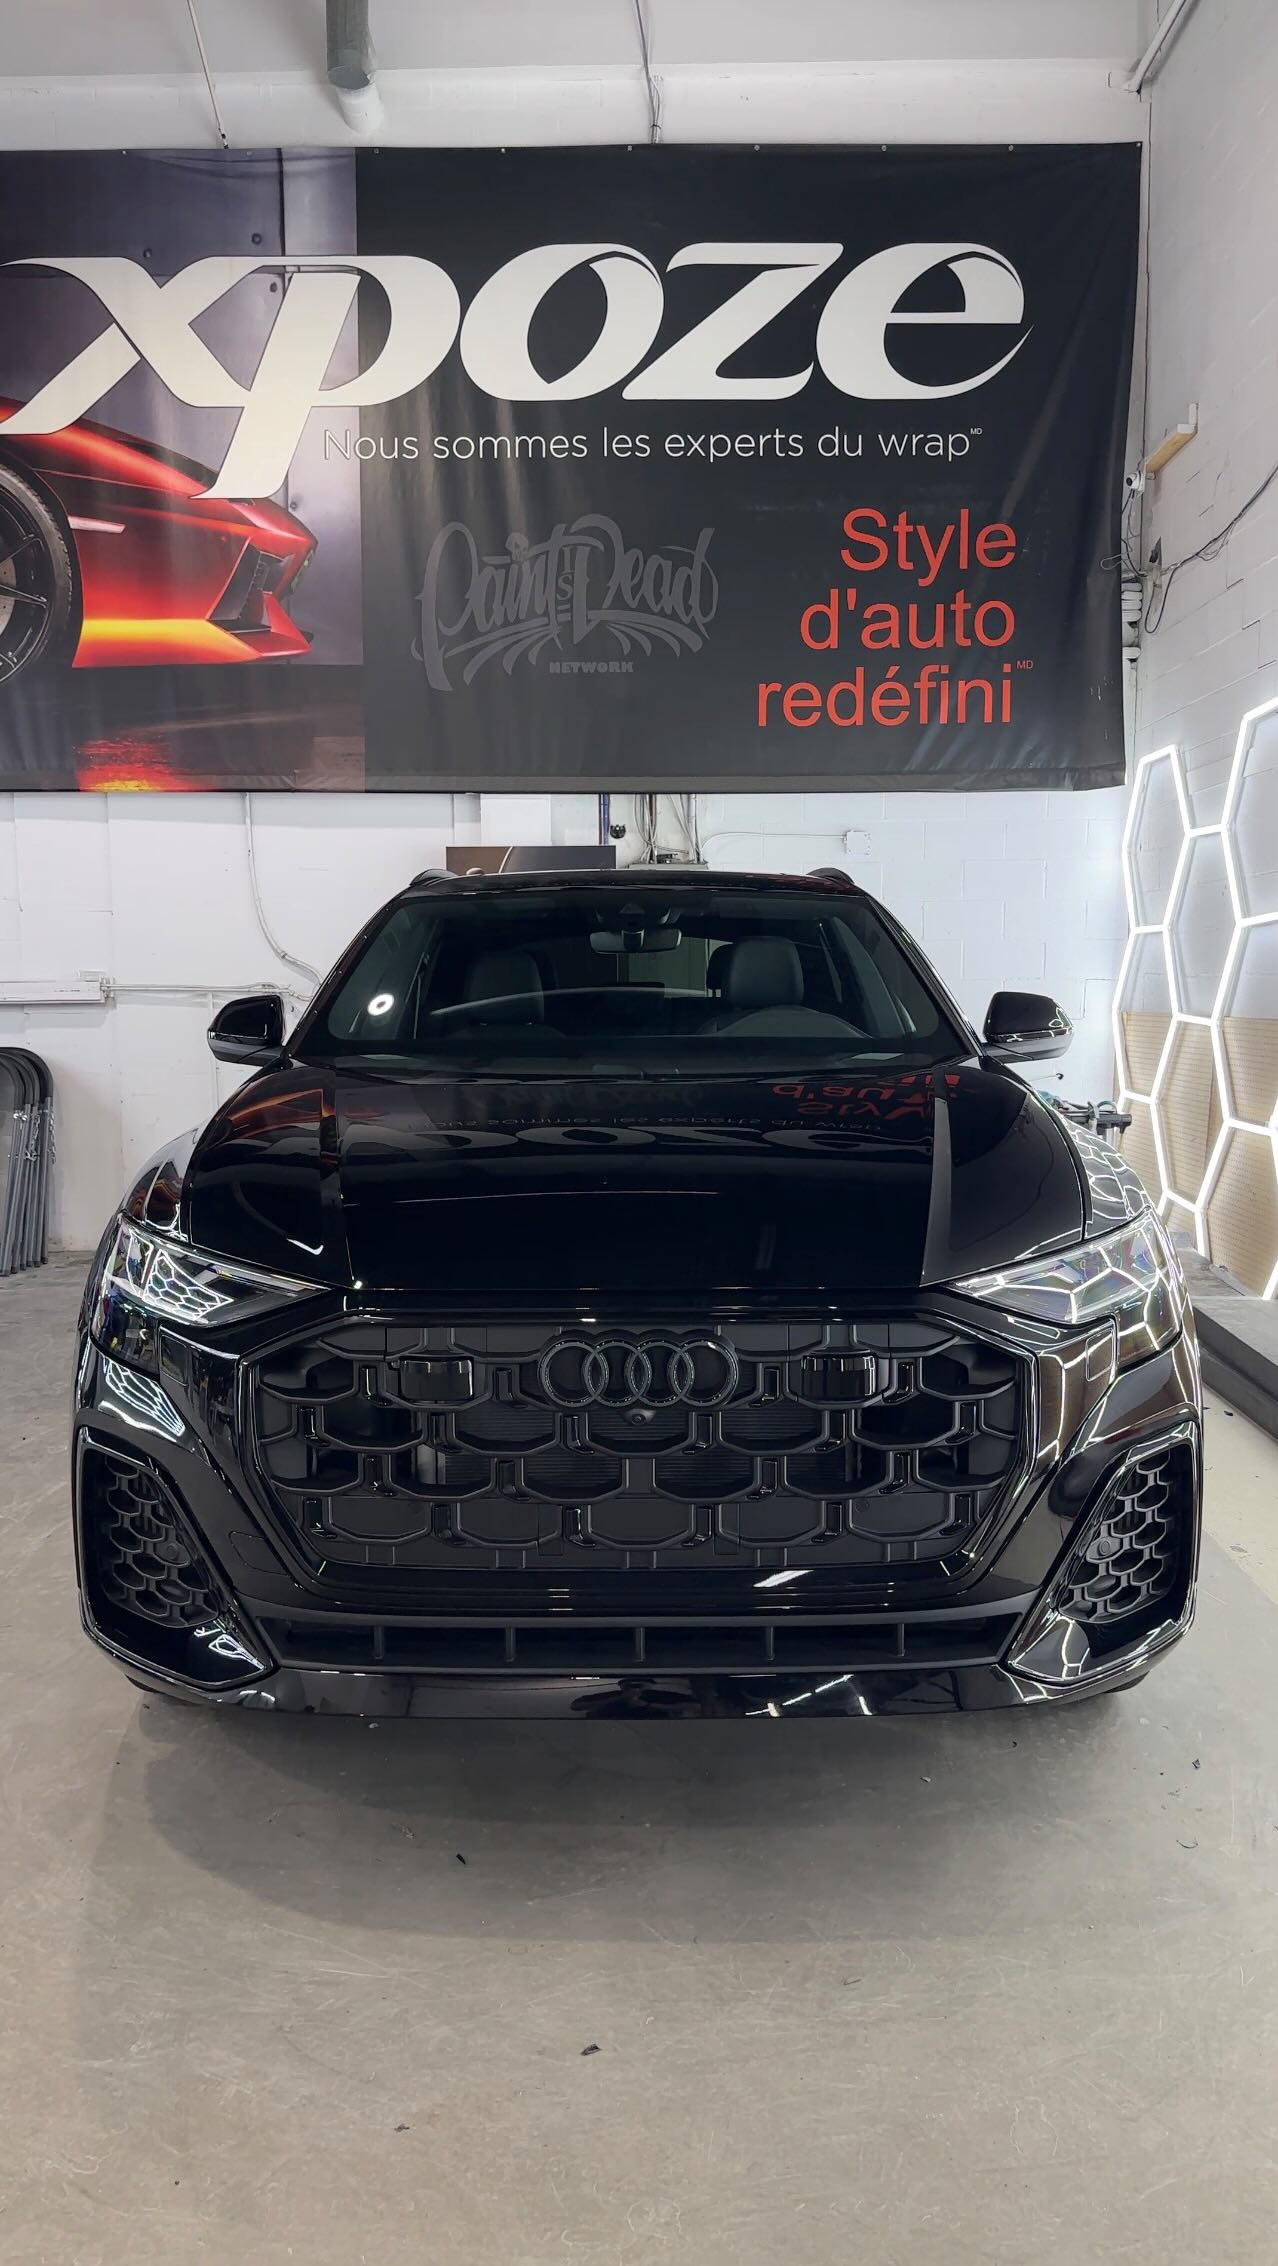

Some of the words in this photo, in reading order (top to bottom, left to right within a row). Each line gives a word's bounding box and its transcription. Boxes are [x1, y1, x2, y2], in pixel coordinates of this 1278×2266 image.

[0, 242, 1034, 500] xpoze
[323, 429, 420, 461] Nous
[433, 434, 589, 460] sommes
[603, 427, 651, 458] les
[664, 429, 804, 463] experts
[817, 426, 863, 457] du
[877, 433, 970, 462] wrap
[841, 507, 1017, 587] Style
[799, 588, 1016, 650] d'auto
[549, 661, 634, 673] NETWORK
[757, 663, 1012, 727] redéfini
